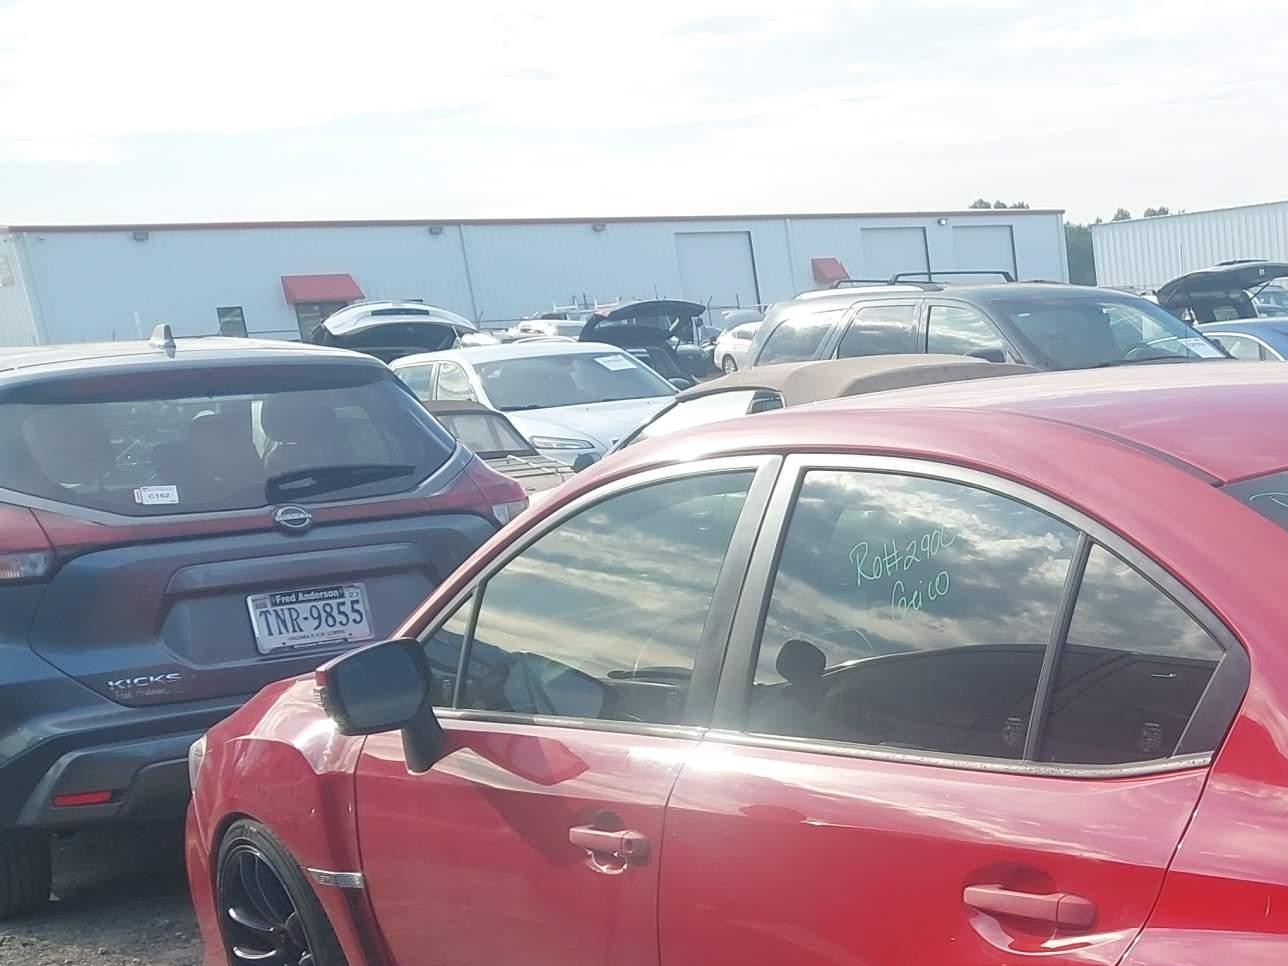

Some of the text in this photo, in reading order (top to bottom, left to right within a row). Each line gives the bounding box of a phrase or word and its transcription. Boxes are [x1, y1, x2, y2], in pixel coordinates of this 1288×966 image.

[275, 588, 340, 605] Fred Anderson
[259, 599, 364, 637] TNR-9855
[107, 673, 182, 691] KICKS
